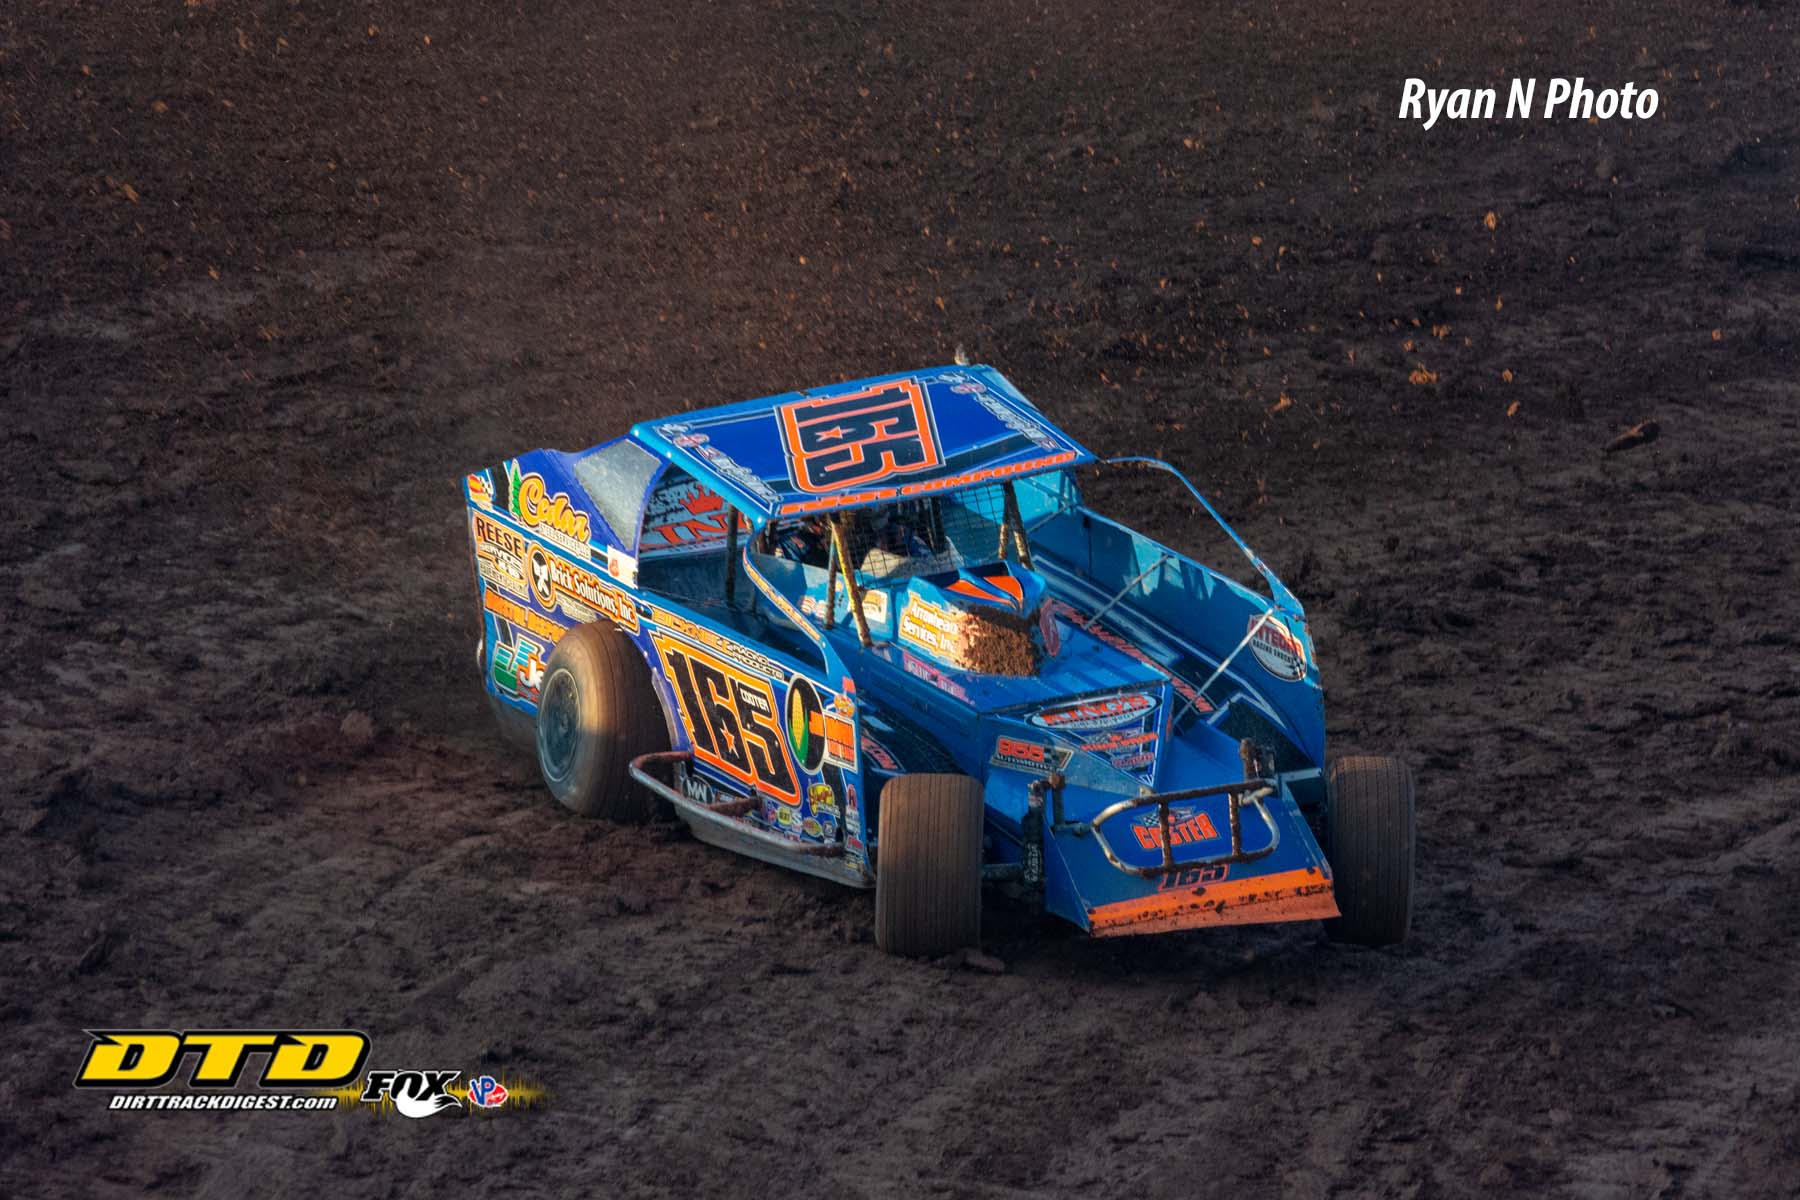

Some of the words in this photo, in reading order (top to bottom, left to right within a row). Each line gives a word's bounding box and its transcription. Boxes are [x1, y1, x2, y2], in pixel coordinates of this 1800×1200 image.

[475, 516, 523, 560] REESE
[519, 476, 589, 542] Cedar
[550, 560, 575, 592] Brick
[573, 573, 619, 617] Solutions,
[618, 597, 637, 625] Inc.
[652, 606, 736, 656] BICKNELL
[656, 640, 800, 803] 165
